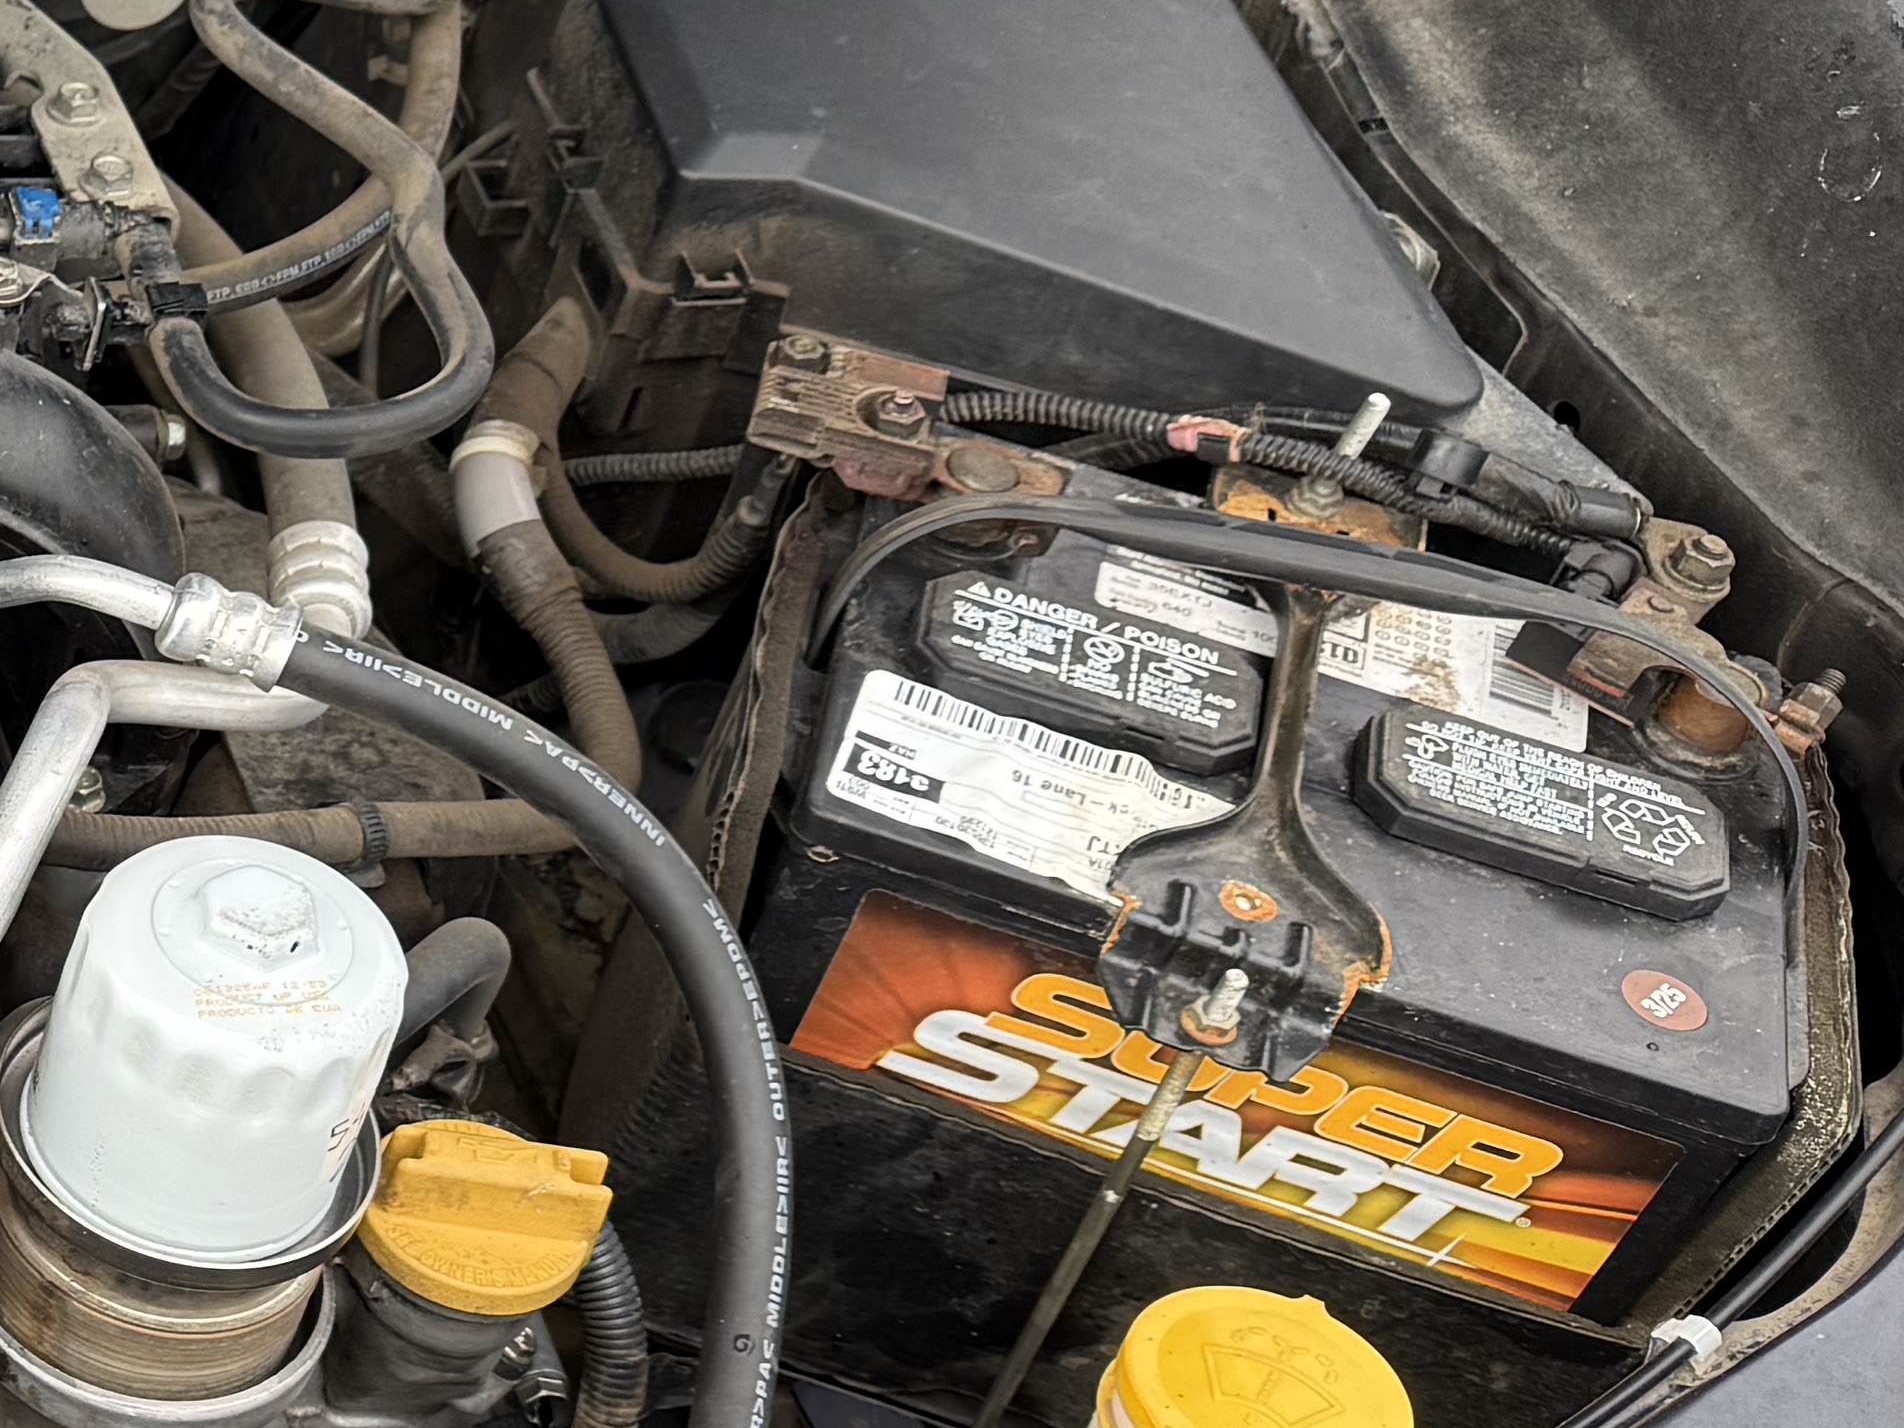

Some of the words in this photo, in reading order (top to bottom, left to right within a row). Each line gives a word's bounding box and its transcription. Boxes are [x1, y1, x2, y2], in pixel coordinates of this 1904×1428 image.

[993, 586, 1098, 629] DANGER
[1124, 625, 1219, 665] POISON
[1203, 692, 1237, 709] ACID
[886, 742, 918, 761] HAZ
[856, 749, 931, 793] 3183
[1010, 768, 1032, 785] 16
[1040, 779, 1088, 807] Lane
[197, 1006, 275, 1020] PRODUCTO
[1640, 982, 1687, 1018] 3/25
[878, 1009, 1532, 1242] START
[510, 1249, 575, 1286] MANUAL
